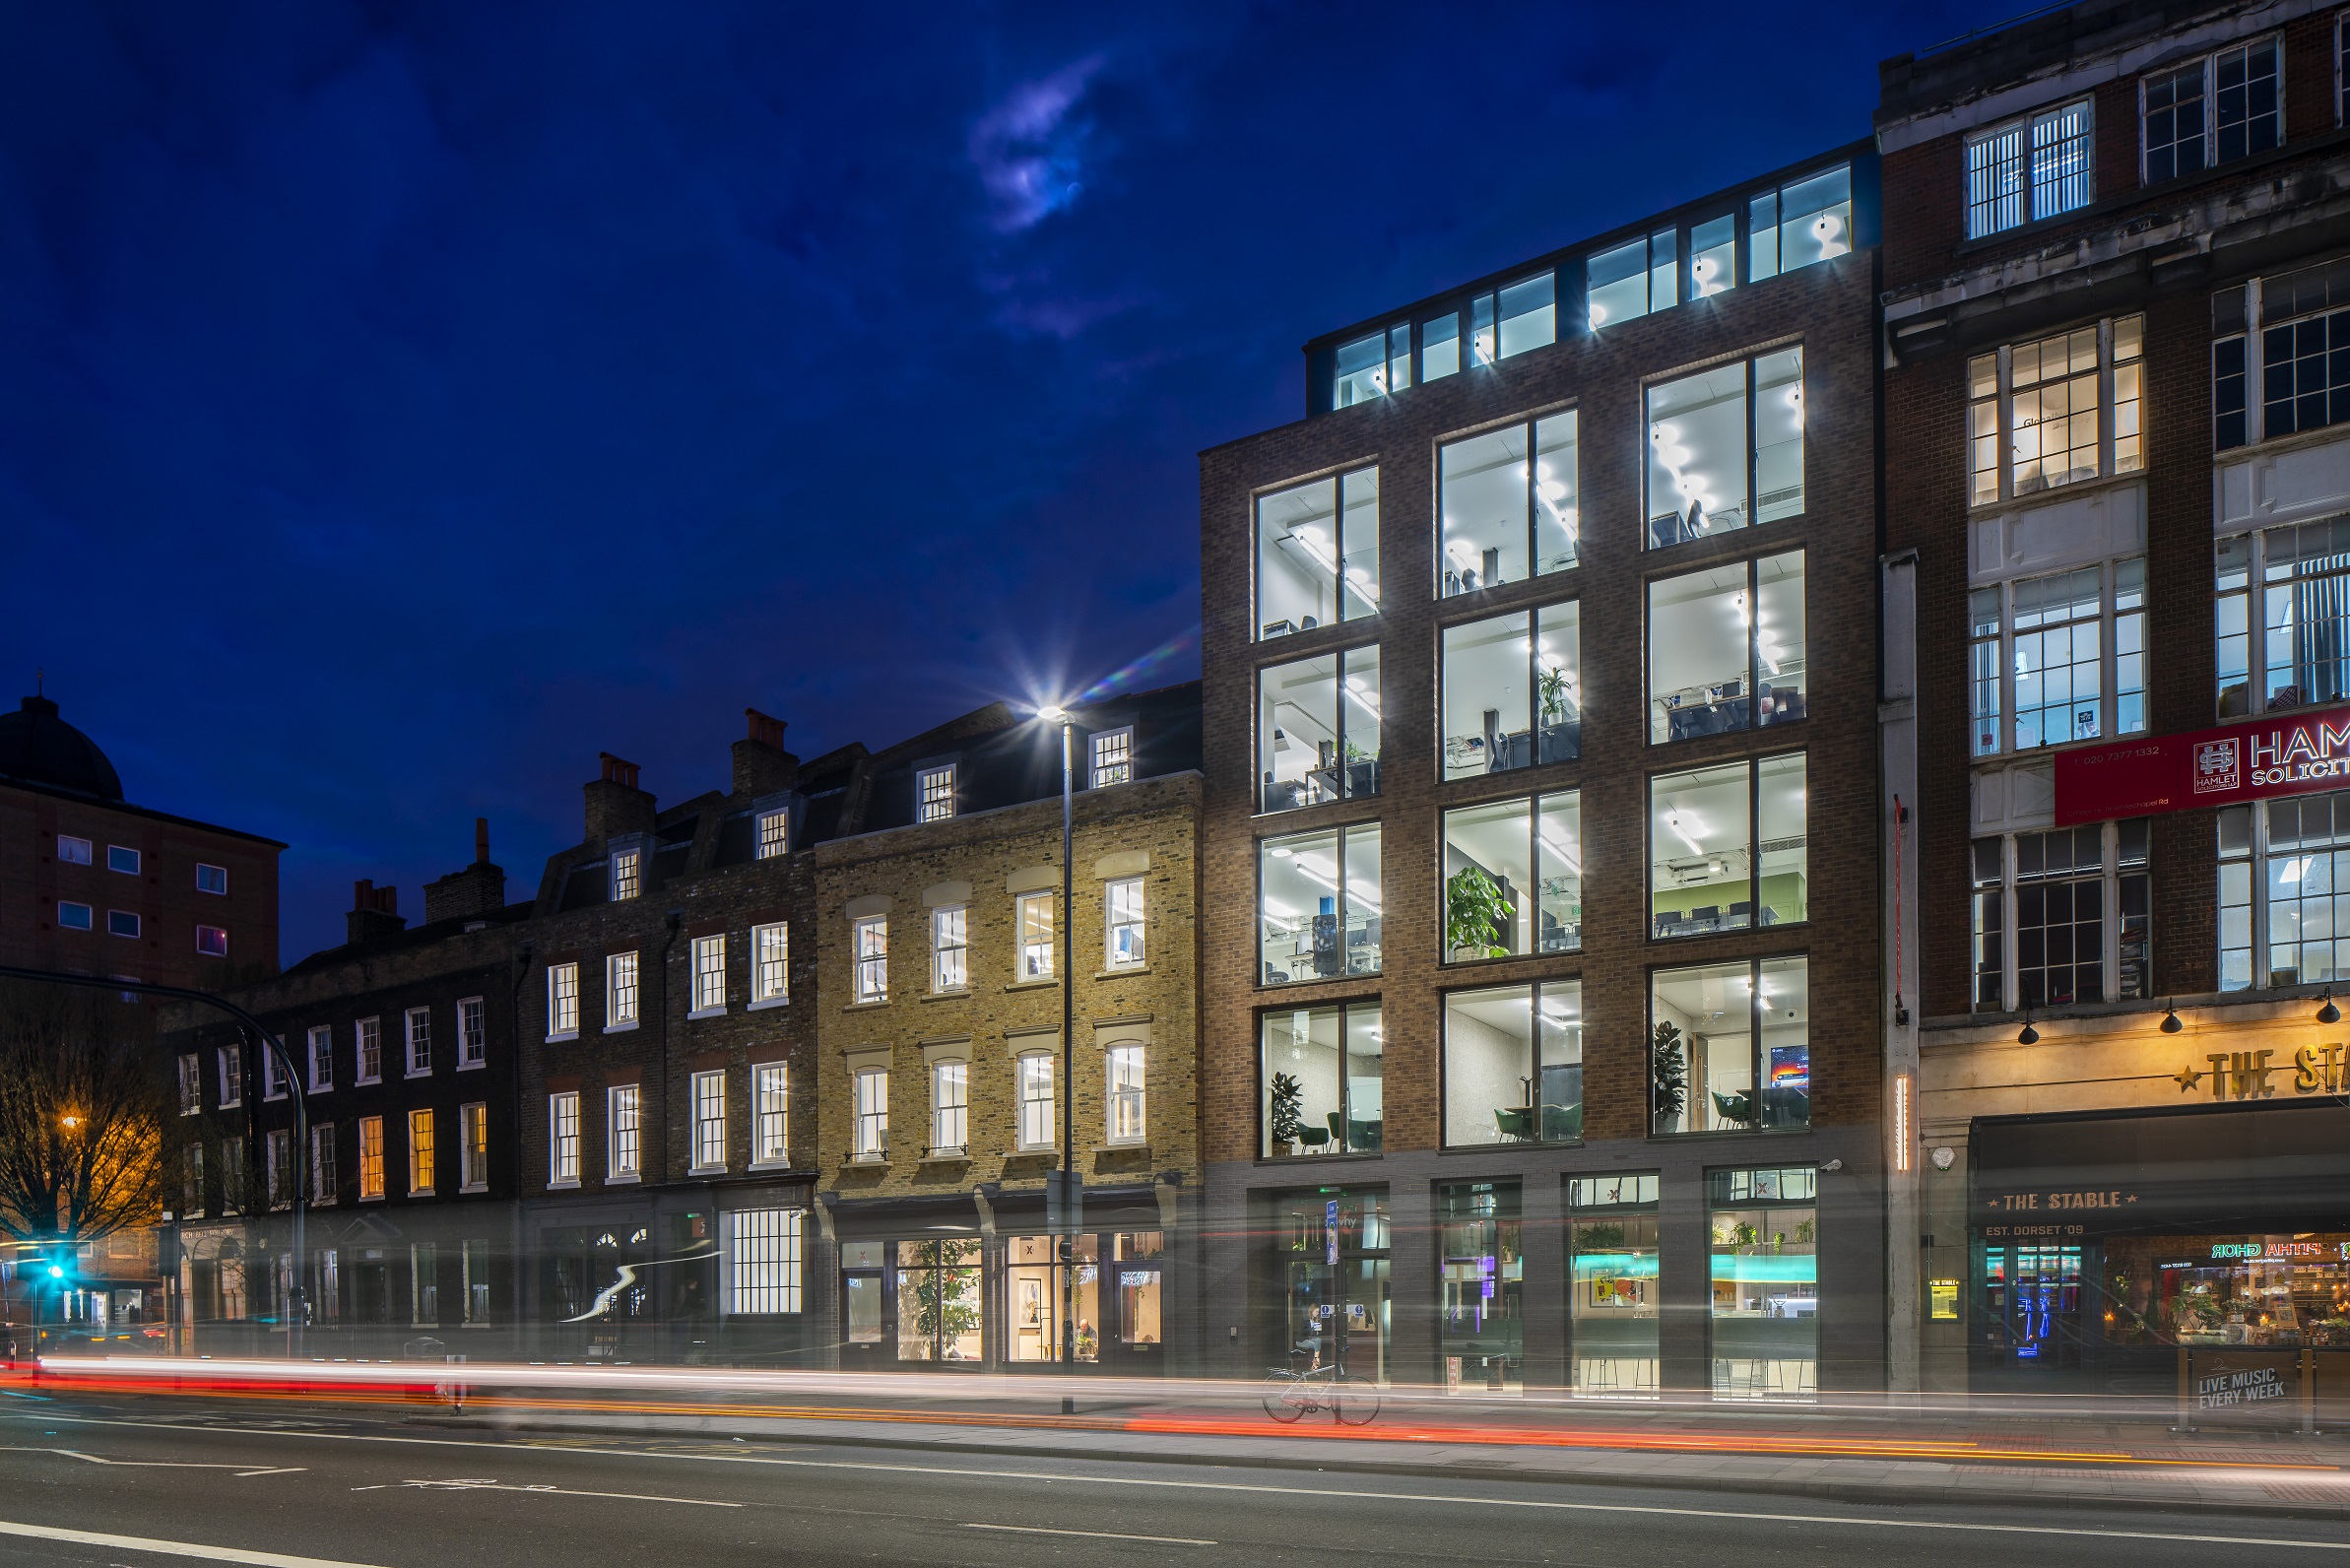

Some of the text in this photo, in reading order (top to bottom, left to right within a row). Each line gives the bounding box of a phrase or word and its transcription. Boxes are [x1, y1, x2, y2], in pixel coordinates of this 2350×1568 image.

[2251, 722, 2350, 768] HAM
[2083, 755, 2104, 765] 020
[2108, 751, 2132, 761] 7377
[2135, 746, 2160, 757] 1332
[2196, 774, 2237, 787] HAMLET
[2114, 799, 2158, 811] Whitechapel
[2207, 1049, 2275, 1096] THE
[2003, 1191, 2122, 1210] THE STABLE
[1986, 1226, 2010, 1236] EST.
[2013, 1225, 2061, 1235] DORSET
[2198, 1367, 2275, 1395] LIVE MUSIC
[2198, 1381, 2285, 1410] EVERY WEEK
